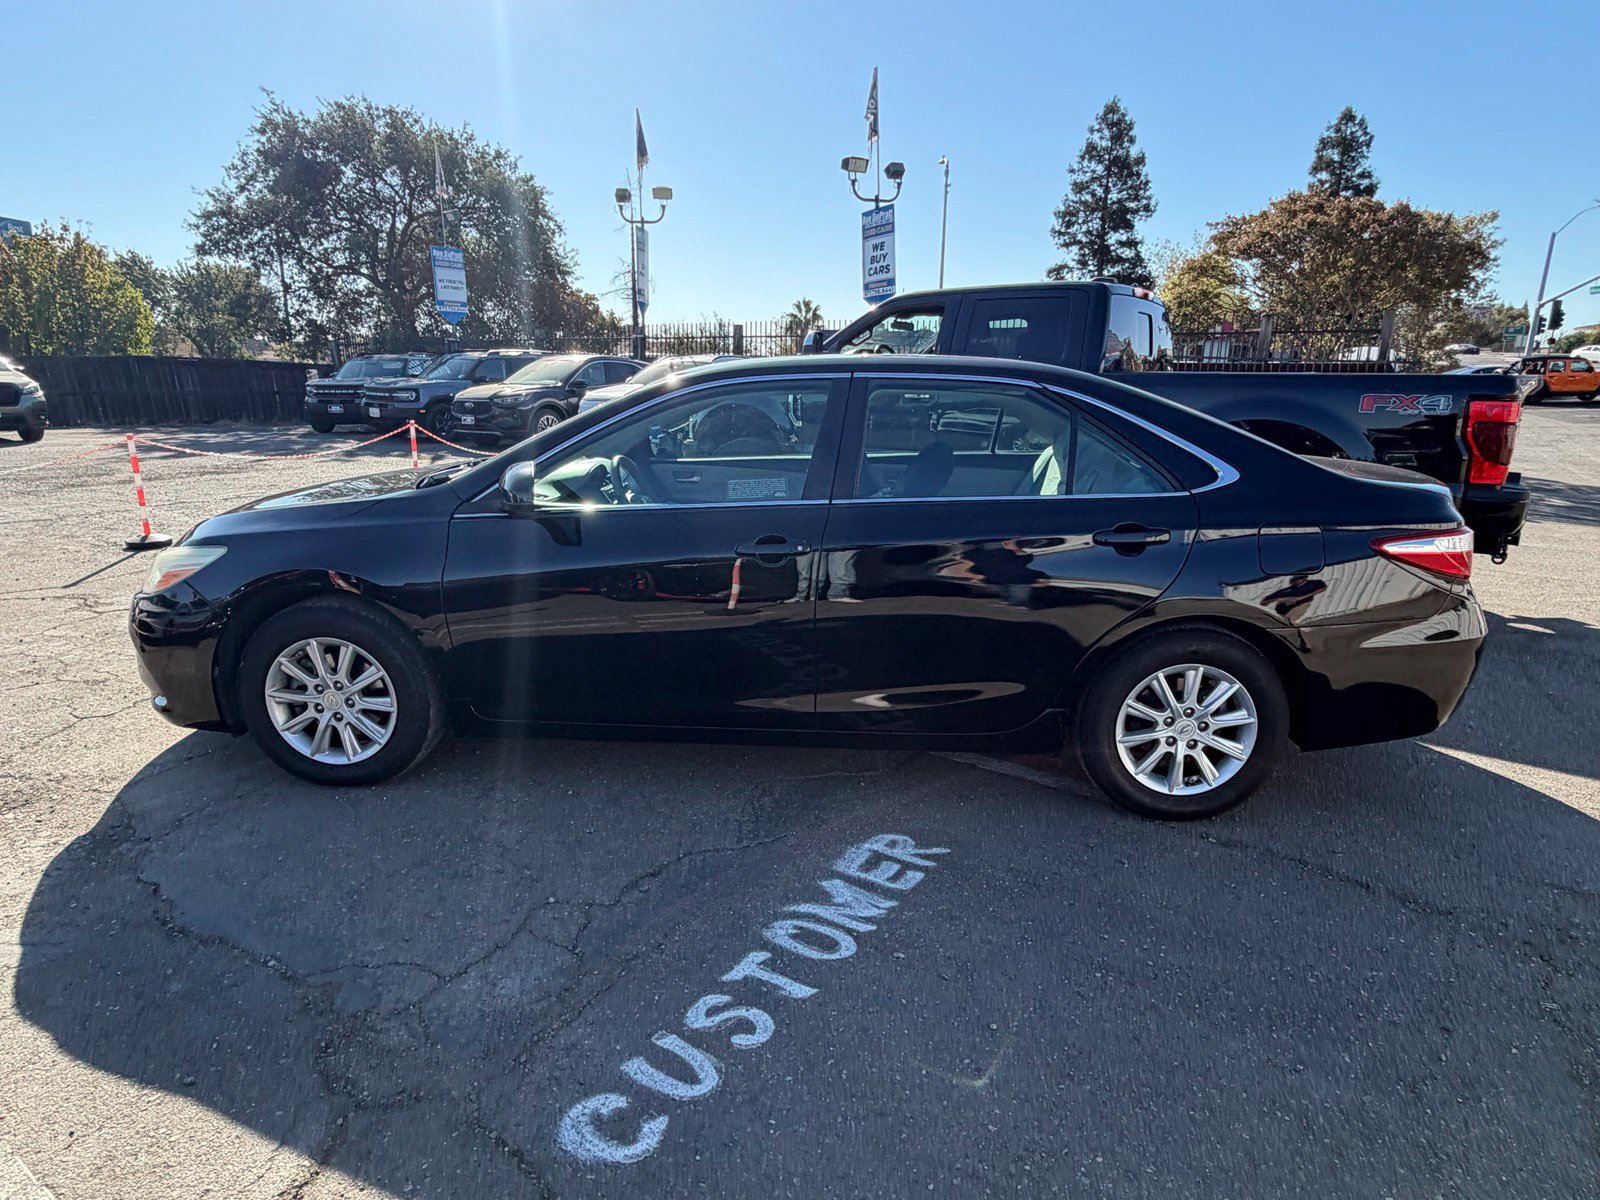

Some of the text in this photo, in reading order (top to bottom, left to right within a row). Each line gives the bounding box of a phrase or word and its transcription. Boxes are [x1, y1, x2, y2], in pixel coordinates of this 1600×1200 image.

[877, 224, 893, 234] CARS
[872, 241, 886, 253] WE
[870, 252, 888, 265] BUY
[868, 264, 891, 277] CARS
[1359, 393, 1453, 414] FX4
[555, 833, 952, 1165] CUSTOMER
